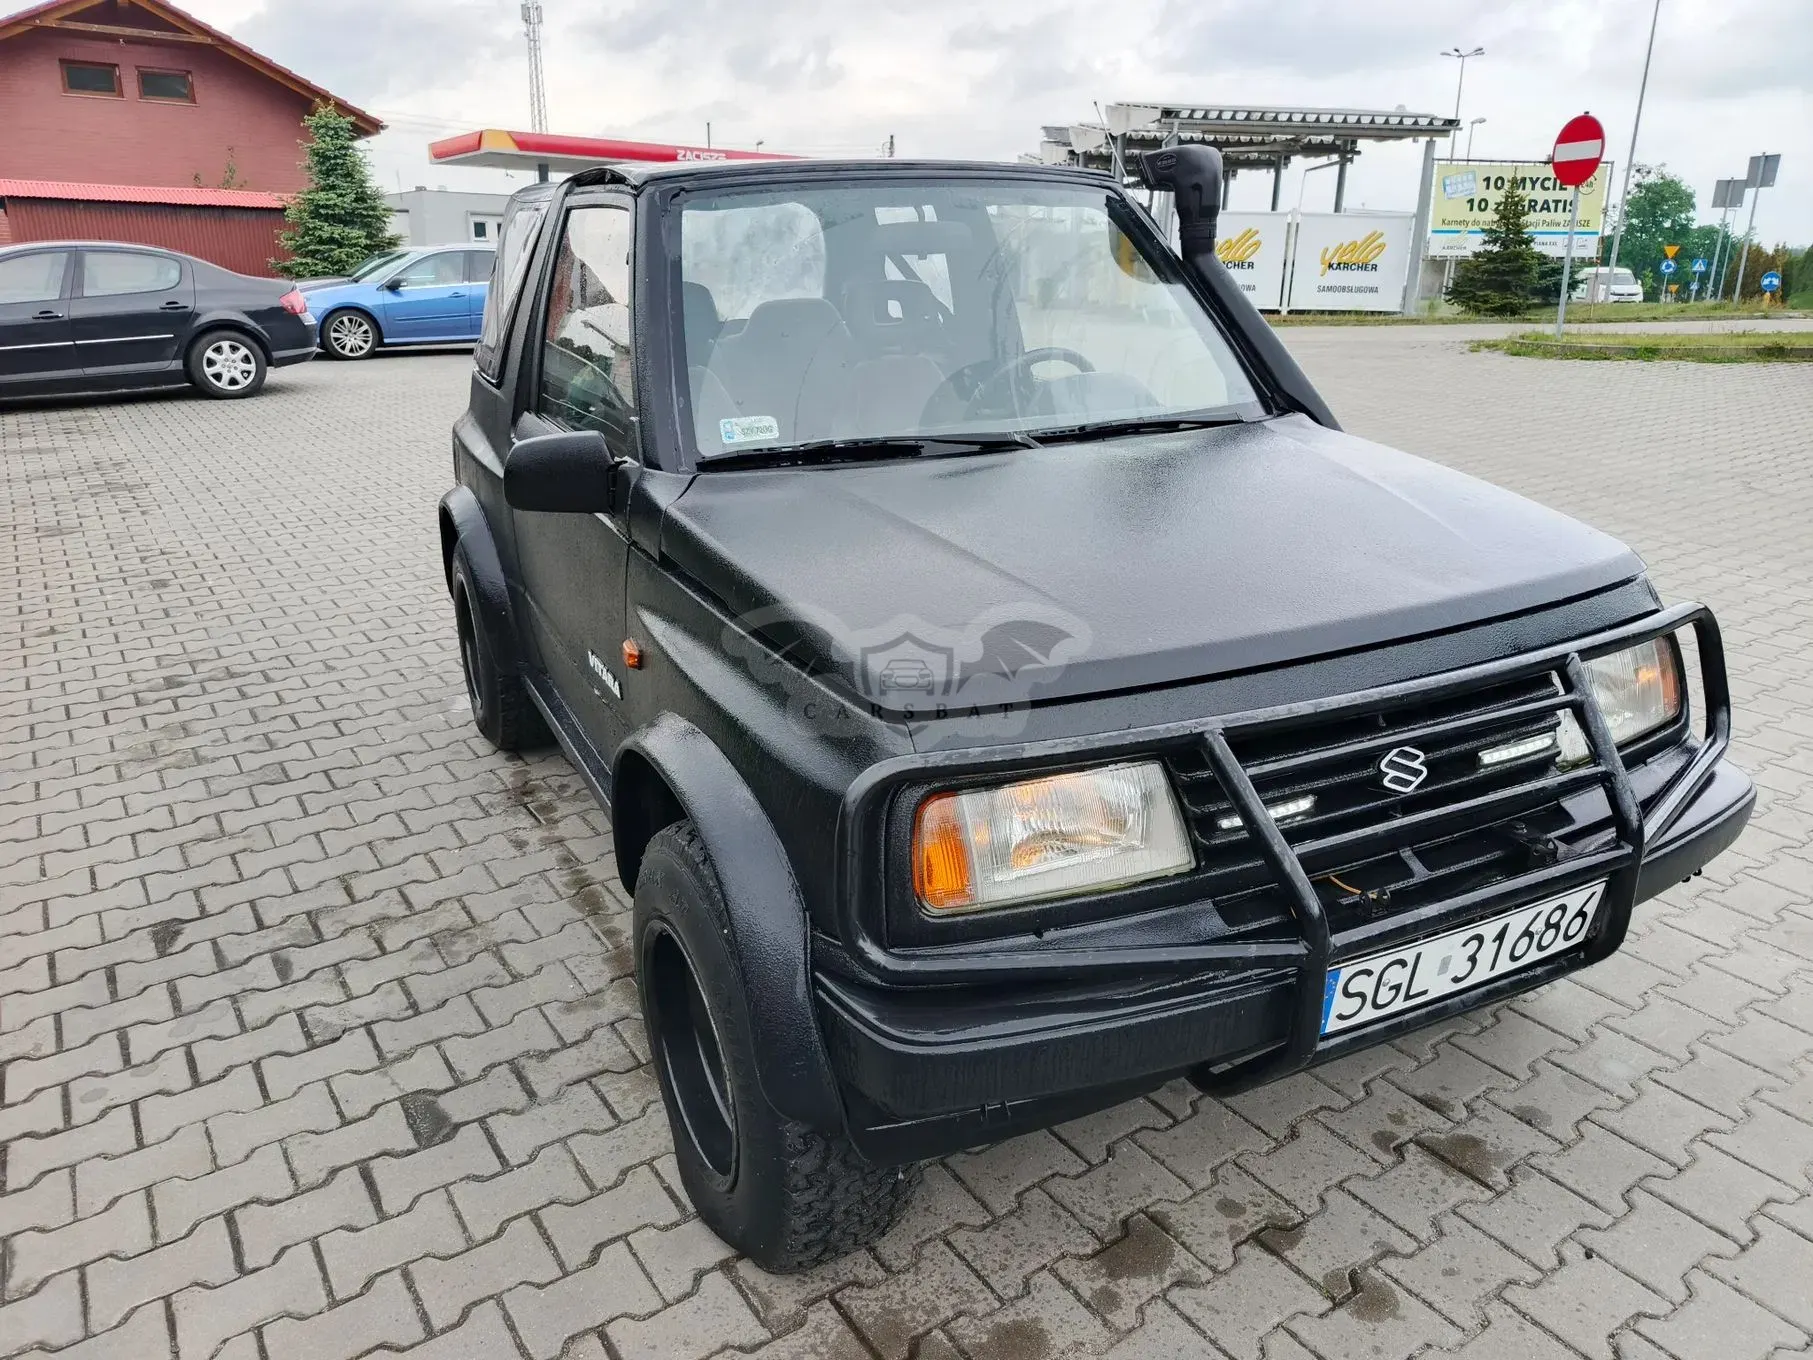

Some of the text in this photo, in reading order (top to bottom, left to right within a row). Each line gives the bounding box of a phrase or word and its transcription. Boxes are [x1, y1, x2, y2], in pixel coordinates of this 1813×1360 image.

[1483, 176, 1505, 190] 10
[1467, 198, 1489, 212] 10
[1441, 218, 1470, 228] Karnety
[1471, 219, 1480, 227] do
[1541, 219, 1561, 227] Paliw
[1562, 219, 1591, 228] ZAISZE
[1215, 227, 1262, 262] ello
[1222, 261, 1255, 270] CHER
[1335, 890, 1597, 1021] SGL 31686
